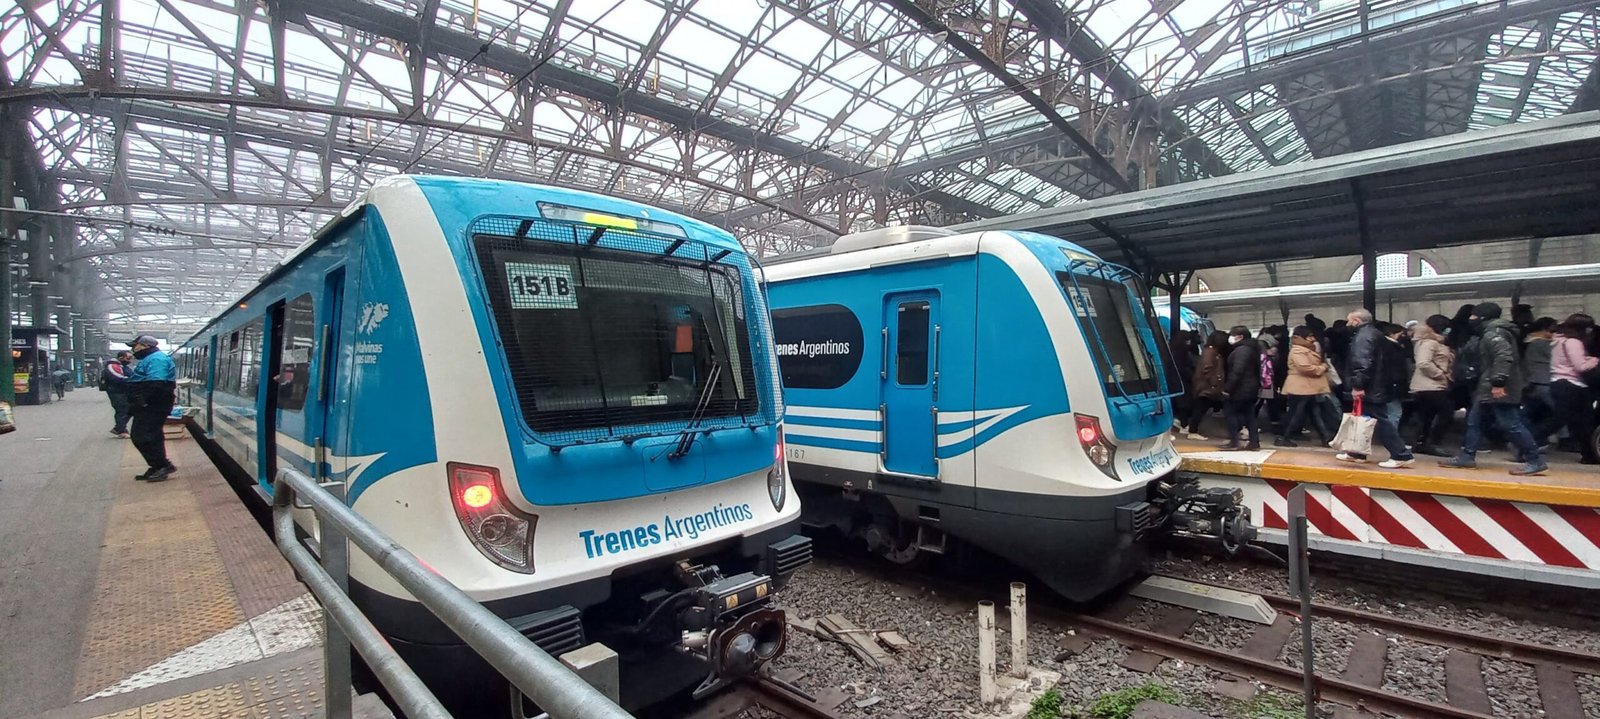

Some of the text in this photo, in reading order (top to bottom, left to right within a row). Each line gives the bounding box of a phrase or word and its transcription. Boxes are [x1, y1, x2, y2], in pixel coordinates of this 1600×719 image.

[513, 275, 570, 296] 151B
[355, 341, 383, 353] Malvinas
[799, 339, 850, 358] Argentinos
[579, 503, 753, 559] Trenes Argentinos
